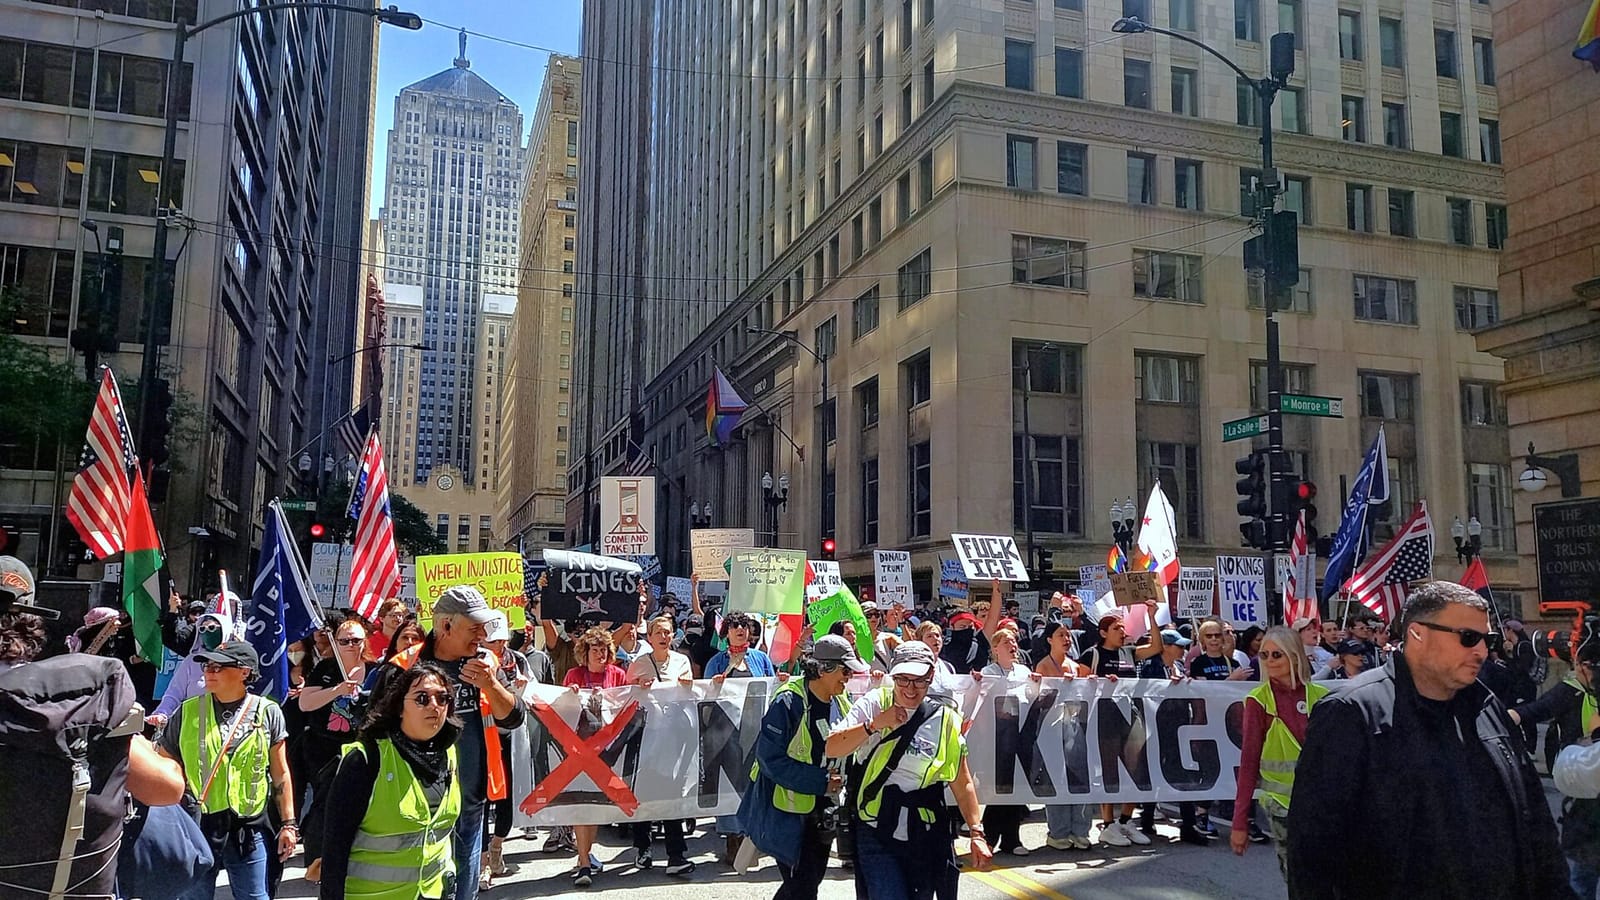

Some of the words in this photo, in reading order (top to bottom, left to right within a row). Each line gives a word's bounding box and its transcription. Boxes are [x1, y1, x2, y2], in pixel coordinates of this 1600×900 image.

[1291, 399, 1321, 411] Monroe
[1228, 426, 1236, 436] La
[1237, 422, 1254, 434] Salle
[1560, 508, 1582, 521] THE
[604, 534, 630, 544] COME
[631, 534, 649, 544] AND
[314, 544, 352, 556] COURAG
[605, 544, 628, 554] TAKE
[630, 544, 646, 554] IT.
[959, 538, 1020, 561] FUCK
[1554, 542, 1593, 557] TRUST
[568, 554, 608, 571] NO
[879, 553, 908, 562] DONALD
[423, 561, 462, 582] WHEN
[467, 558, 522, 577] INJUSTICE
[813, 562, 828, 573] YOU
[881, 564, 905, 573] TRUMP
[969, 559, 1018, 579] ICE
[1218, 557, 1235, 576] NO
[1236, 557, 1264, 576] KINGS
[495, 580, 521, 592] LAW
[560, 570, 637, 594] KINGS
[829, 576, 841, 586] FOR
[819, 586, 828, 595] US
[1225, 580, 1259, 601] FUCK
[1233, 603, 1257, 622] ICE
